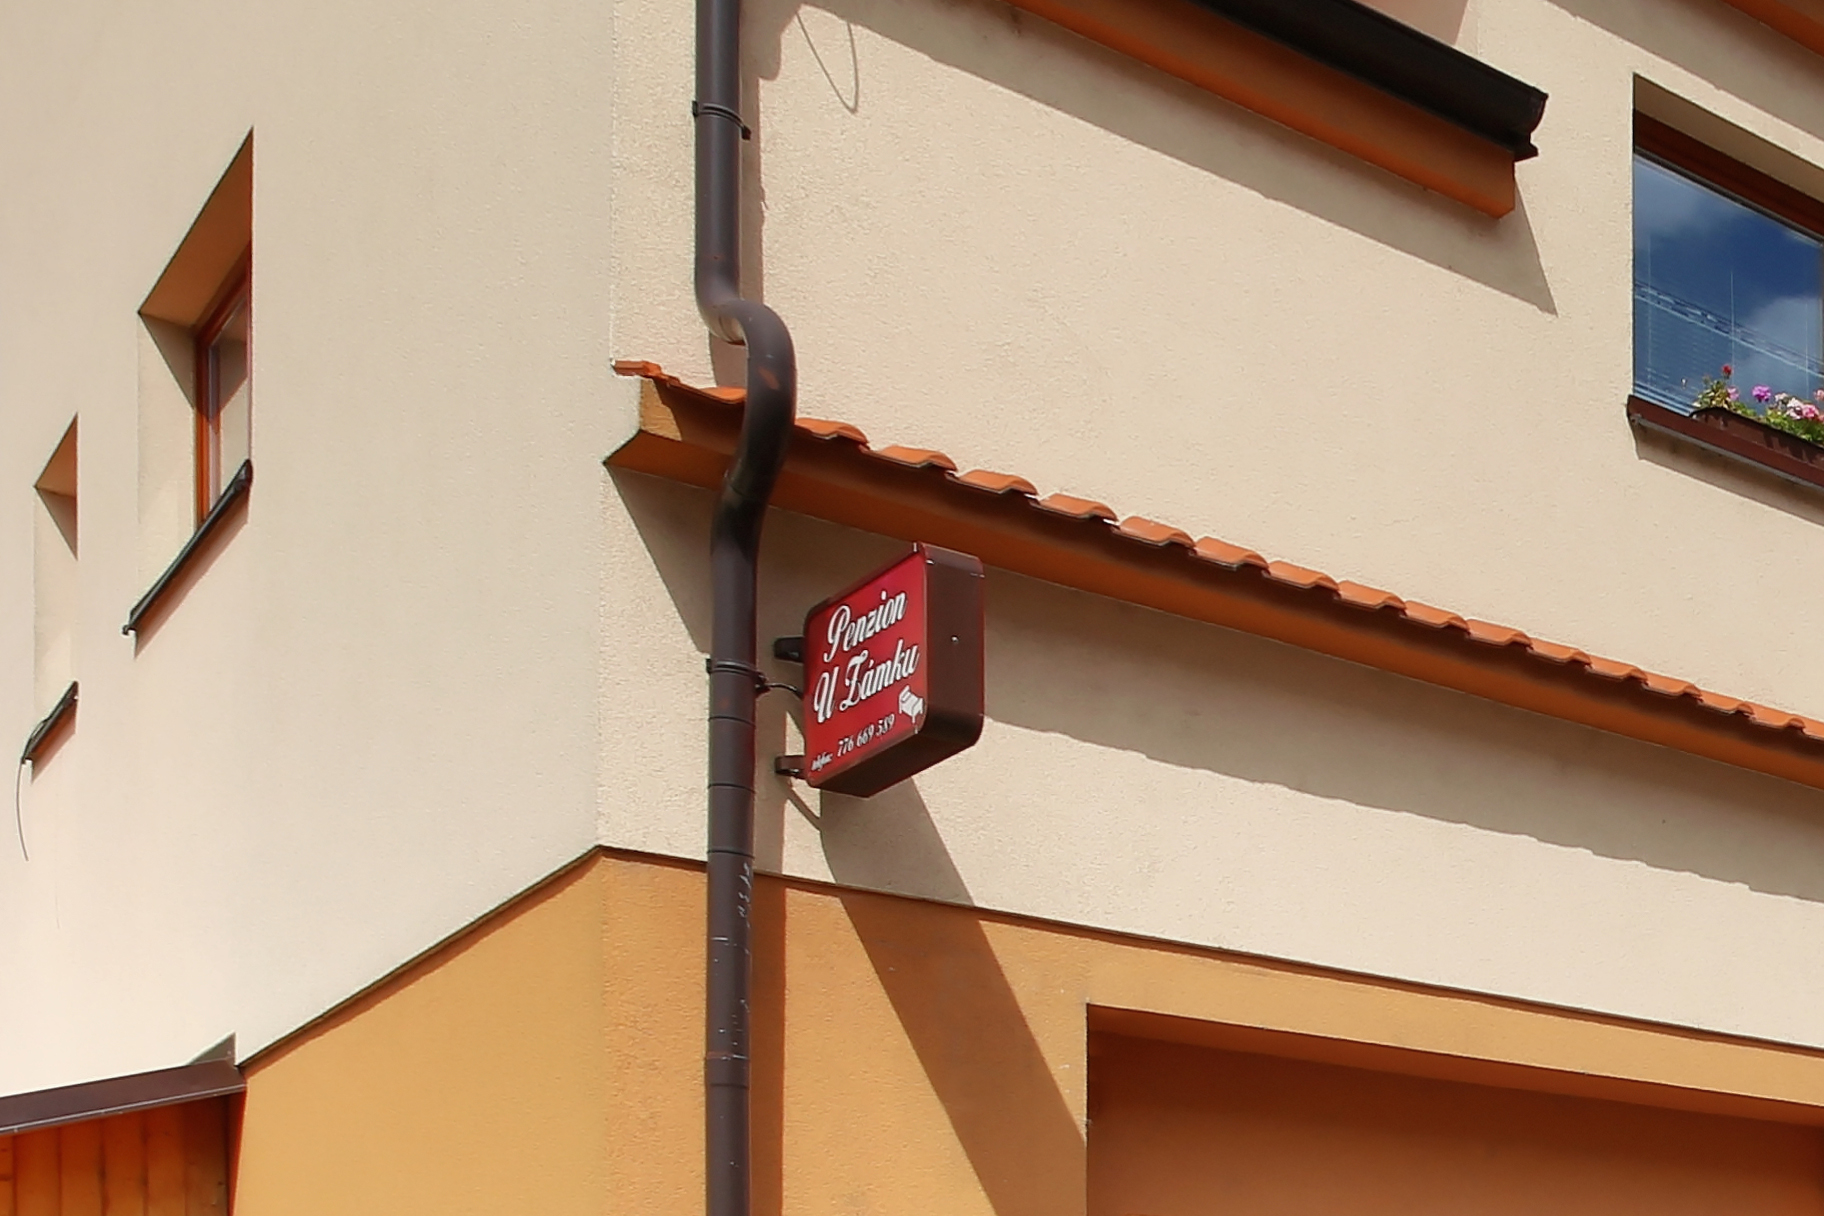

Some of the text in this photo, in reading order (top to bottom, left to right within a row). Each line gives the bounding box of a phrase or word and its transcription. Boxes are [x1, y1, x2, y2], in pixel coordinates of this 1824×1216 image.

[823, 590, 906, 663] Penzion
[813, 639, 919, 723] U Zámku
